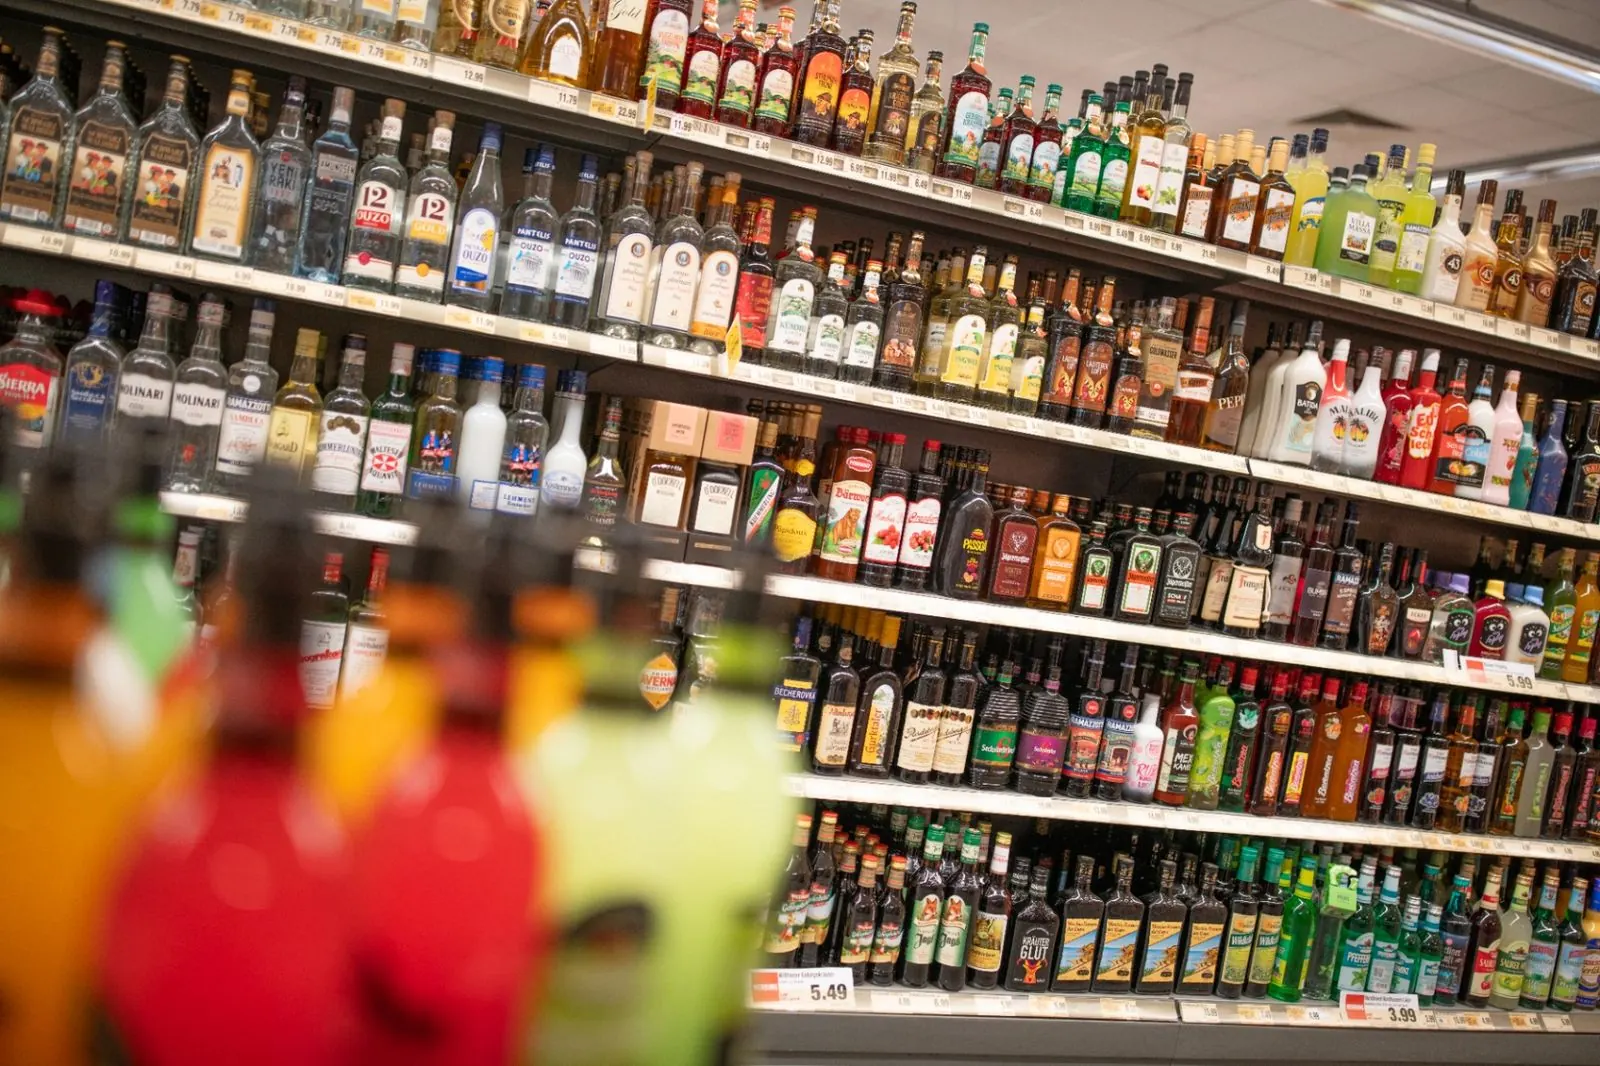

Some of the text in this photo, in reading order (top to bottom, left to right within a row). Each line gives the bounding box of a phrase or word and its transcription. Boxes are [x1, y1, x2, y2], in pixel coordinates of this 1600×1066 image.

[413, 56, 428, 68] 7.79
[464, 69, 484, 82] 12.99
[558, 92, 577, 104] 11.79
[618, 106, 637, 118] 22.99
[674, 120, 692, 132] 11.99
[816, 153, 833, 166] 12.99
[270, 162, 298, 177] YENI
[269, 174, 296, 190] RAKI
[363, 186, 387, 208] 12
[955, 187, 971, 200] 11.99
[420, 198, 444, 220] 12
[356, 210, 390, 225] OUZO
[520, 242, 543, 252] OUZO
[462, 249, 488, 264] OUZO
[569, 252, 591, 263] OUZO
[1448, 258, 1460, 269] 43
[1481, 269, 1493, 279] 43
[1508, 274, 1520, 285] 43
[1540, 285, 1552, 296] 43
[1583, 294, 1594, 305] 43
[0, 376, 45, 396] SIERRA
[176, 393, 220, 409] MOLINARI
[1507, 675, 1533, 689] 5.99
[774, 686, 816, 700] BECHEROVKA
[1108, 721, 1135, 733] RAMAZZ
[1022, 934, 1050, 947] KRÄUTER
[1020, 945, 1047, 960] GLUT
[810, 984, 847, 1000] 5.49
[1388, 1008, 1417, 1022] 3.99
